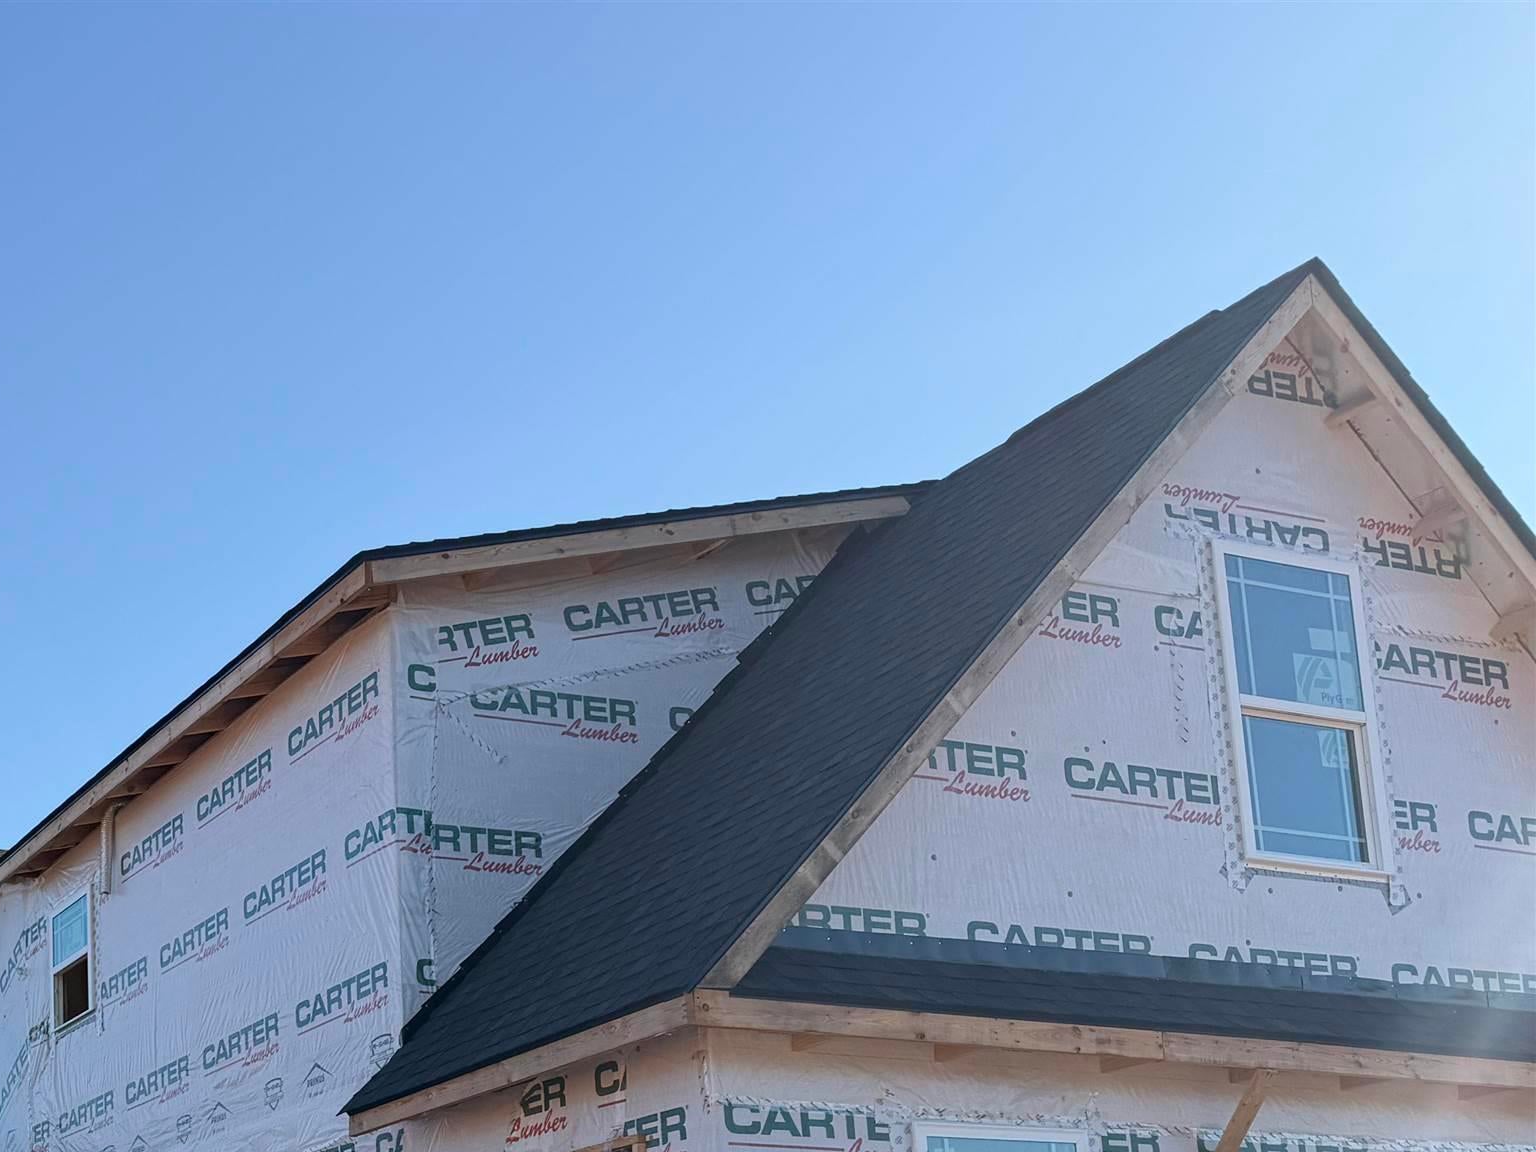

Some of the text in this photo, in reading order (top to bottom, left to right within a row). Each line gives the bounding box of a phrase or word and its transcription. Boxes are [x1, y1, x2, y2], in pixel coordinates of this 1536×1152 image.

[563, 585, 720, 633] CARTER
[654, 612, 725, 638] Lumber
[438, 613, 535, 652] RTER
[1038, 615, 1123, 649] Lumber
[464, 640, 539, 668] Lumber
[287, 671, 380, 757] CARTER
[470, 686, 638, 727] CARTER
[1441, 680, 1512, 710] Lumber
[334, 700, 380, 744] Lumber
[561, 719, 639, 745] Lumber
[196, 748, 272, 822] CARTER
[234, 776, 272, 814] Lumber
[943, 770, 1032, 802] Lumber
[120, 813, 184, 877] CARTER
[432, 822, 543, 859] RTER
[243, 848, 327, 920] CARTER
[464, 850, 544, 877] Lumber
[286, 876, 327, 912] Lumber
[0, 915, 48, 993] CARTER
[159, 908, 230, 970] CARTER
[99, 956, 148, 1001] ARTER
[296, 960, 389, 1029] CARTER
[343, 989, 390, 1026] Lumber
[202, 1011, 281, 1071] CARTER
[125, 1055, 191, 1106] CARTER
[59, 1089, 114, 1135] CARTER
[724, 1103, 891, 1142] CARTE
